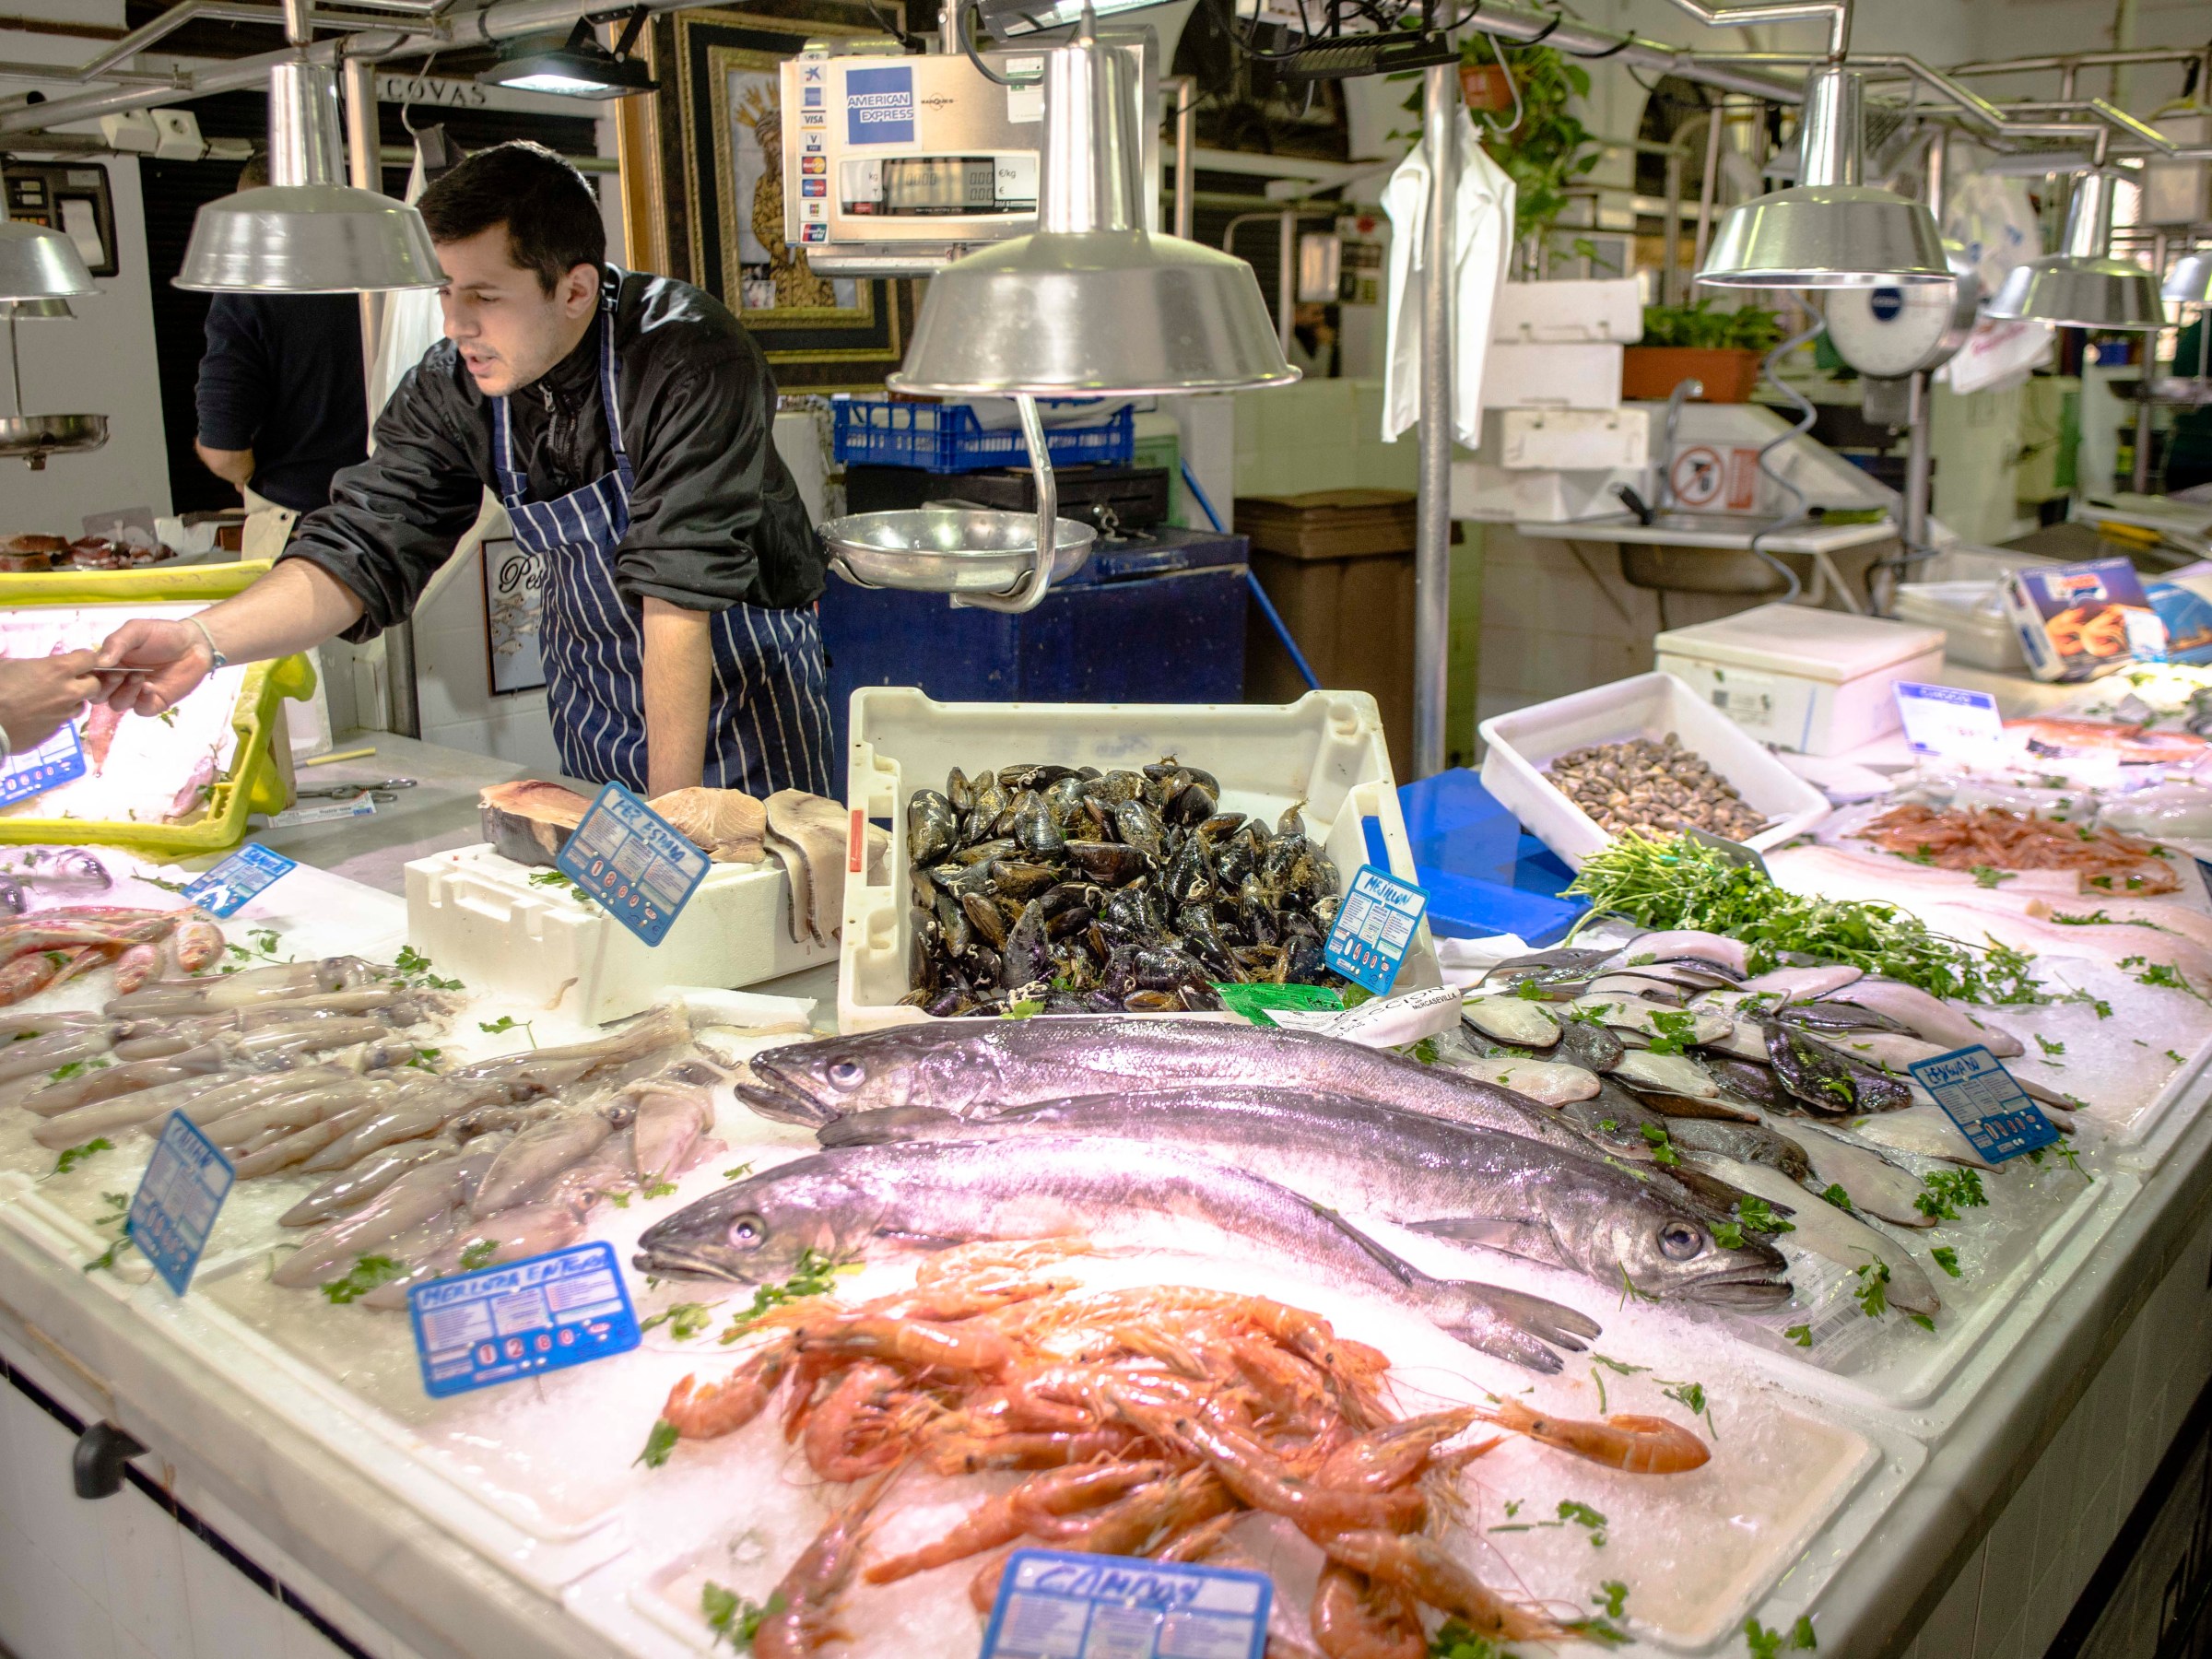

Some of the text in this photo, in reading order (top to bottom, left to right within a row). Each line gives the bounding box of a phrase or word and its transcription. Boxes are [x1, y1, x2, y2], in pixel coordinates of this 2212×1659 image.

[377, 76, 487, 107] COVAS
[847, 93, 910, 107] AMERICAN
[805, 115, 824, 124] VISA
[861, 109, 914, 122] EXPRESS
[998, 169, 1017, 180] €/kg
[1412, 993, 1457, 1010] MERCASEVILLA
